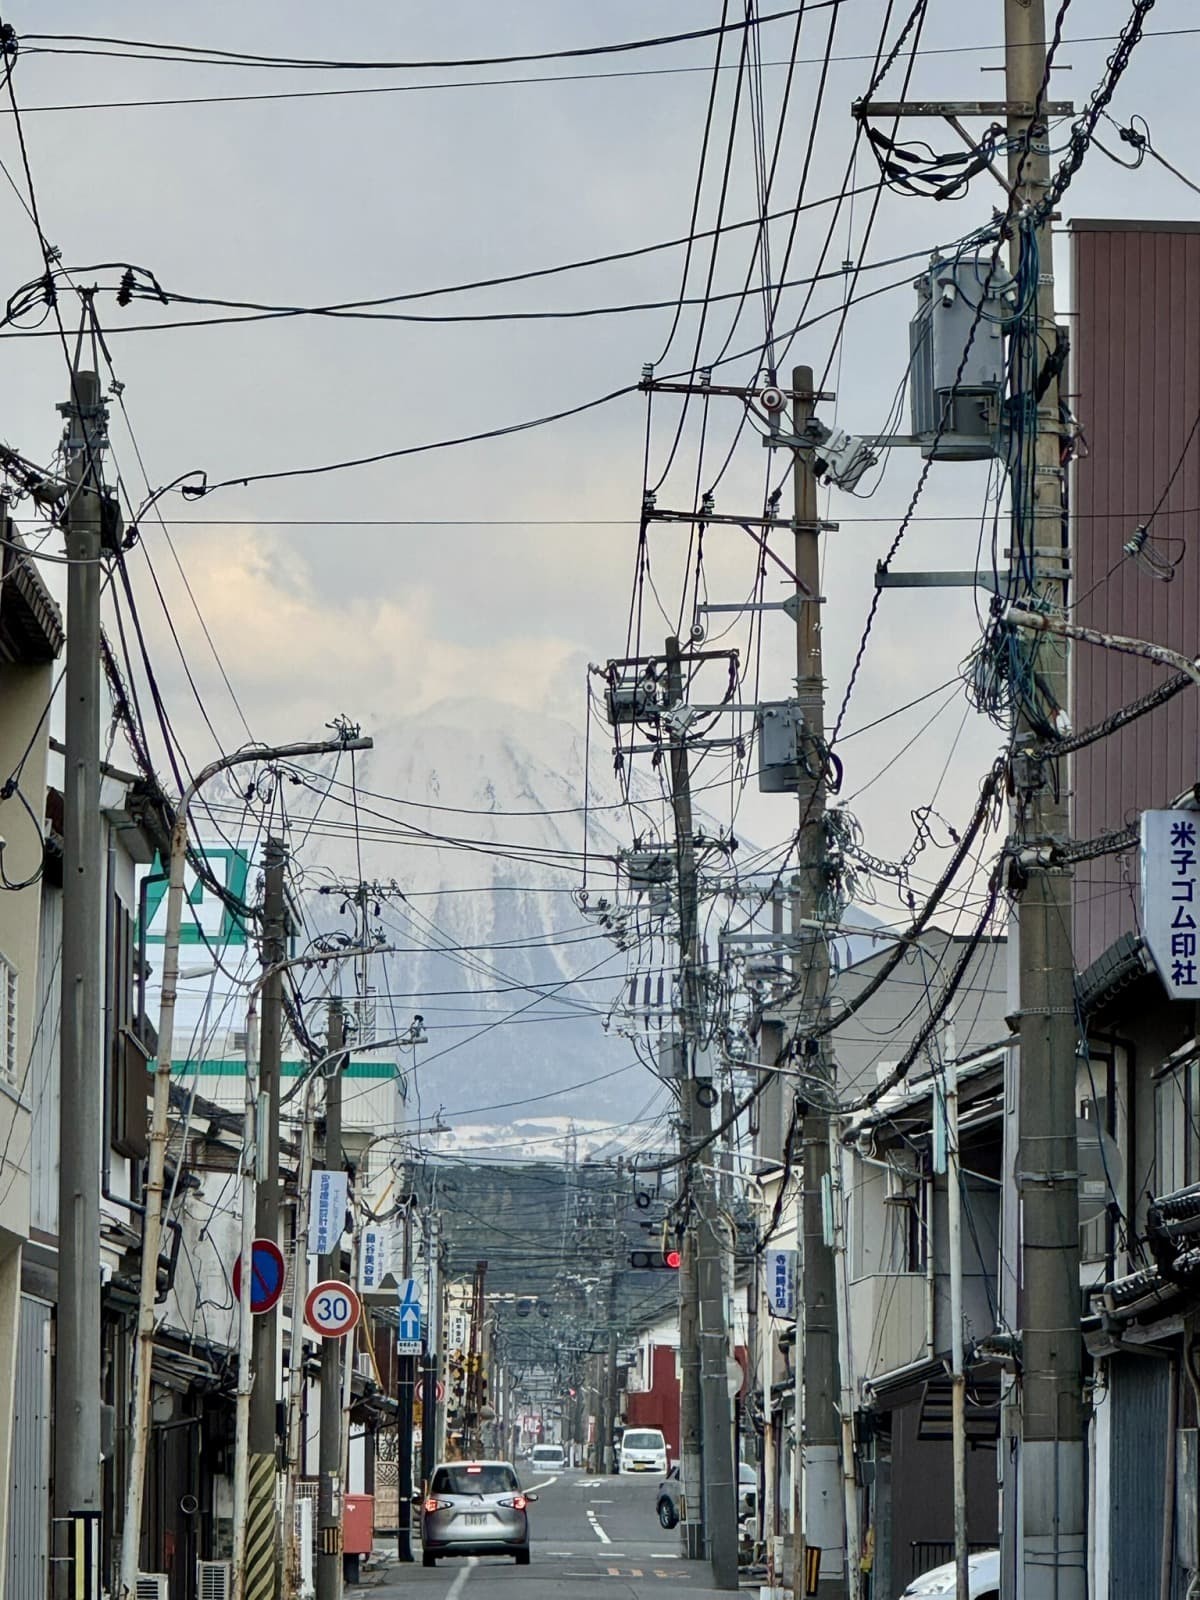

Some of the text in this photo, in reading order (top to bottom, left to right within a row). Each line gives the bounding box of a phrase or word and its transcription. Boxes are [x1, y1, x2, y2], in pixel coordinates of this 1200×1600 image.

[1170, 821, 1198, 986] 米子ゴム印社
[317, 1297, 348, 1321] 30
